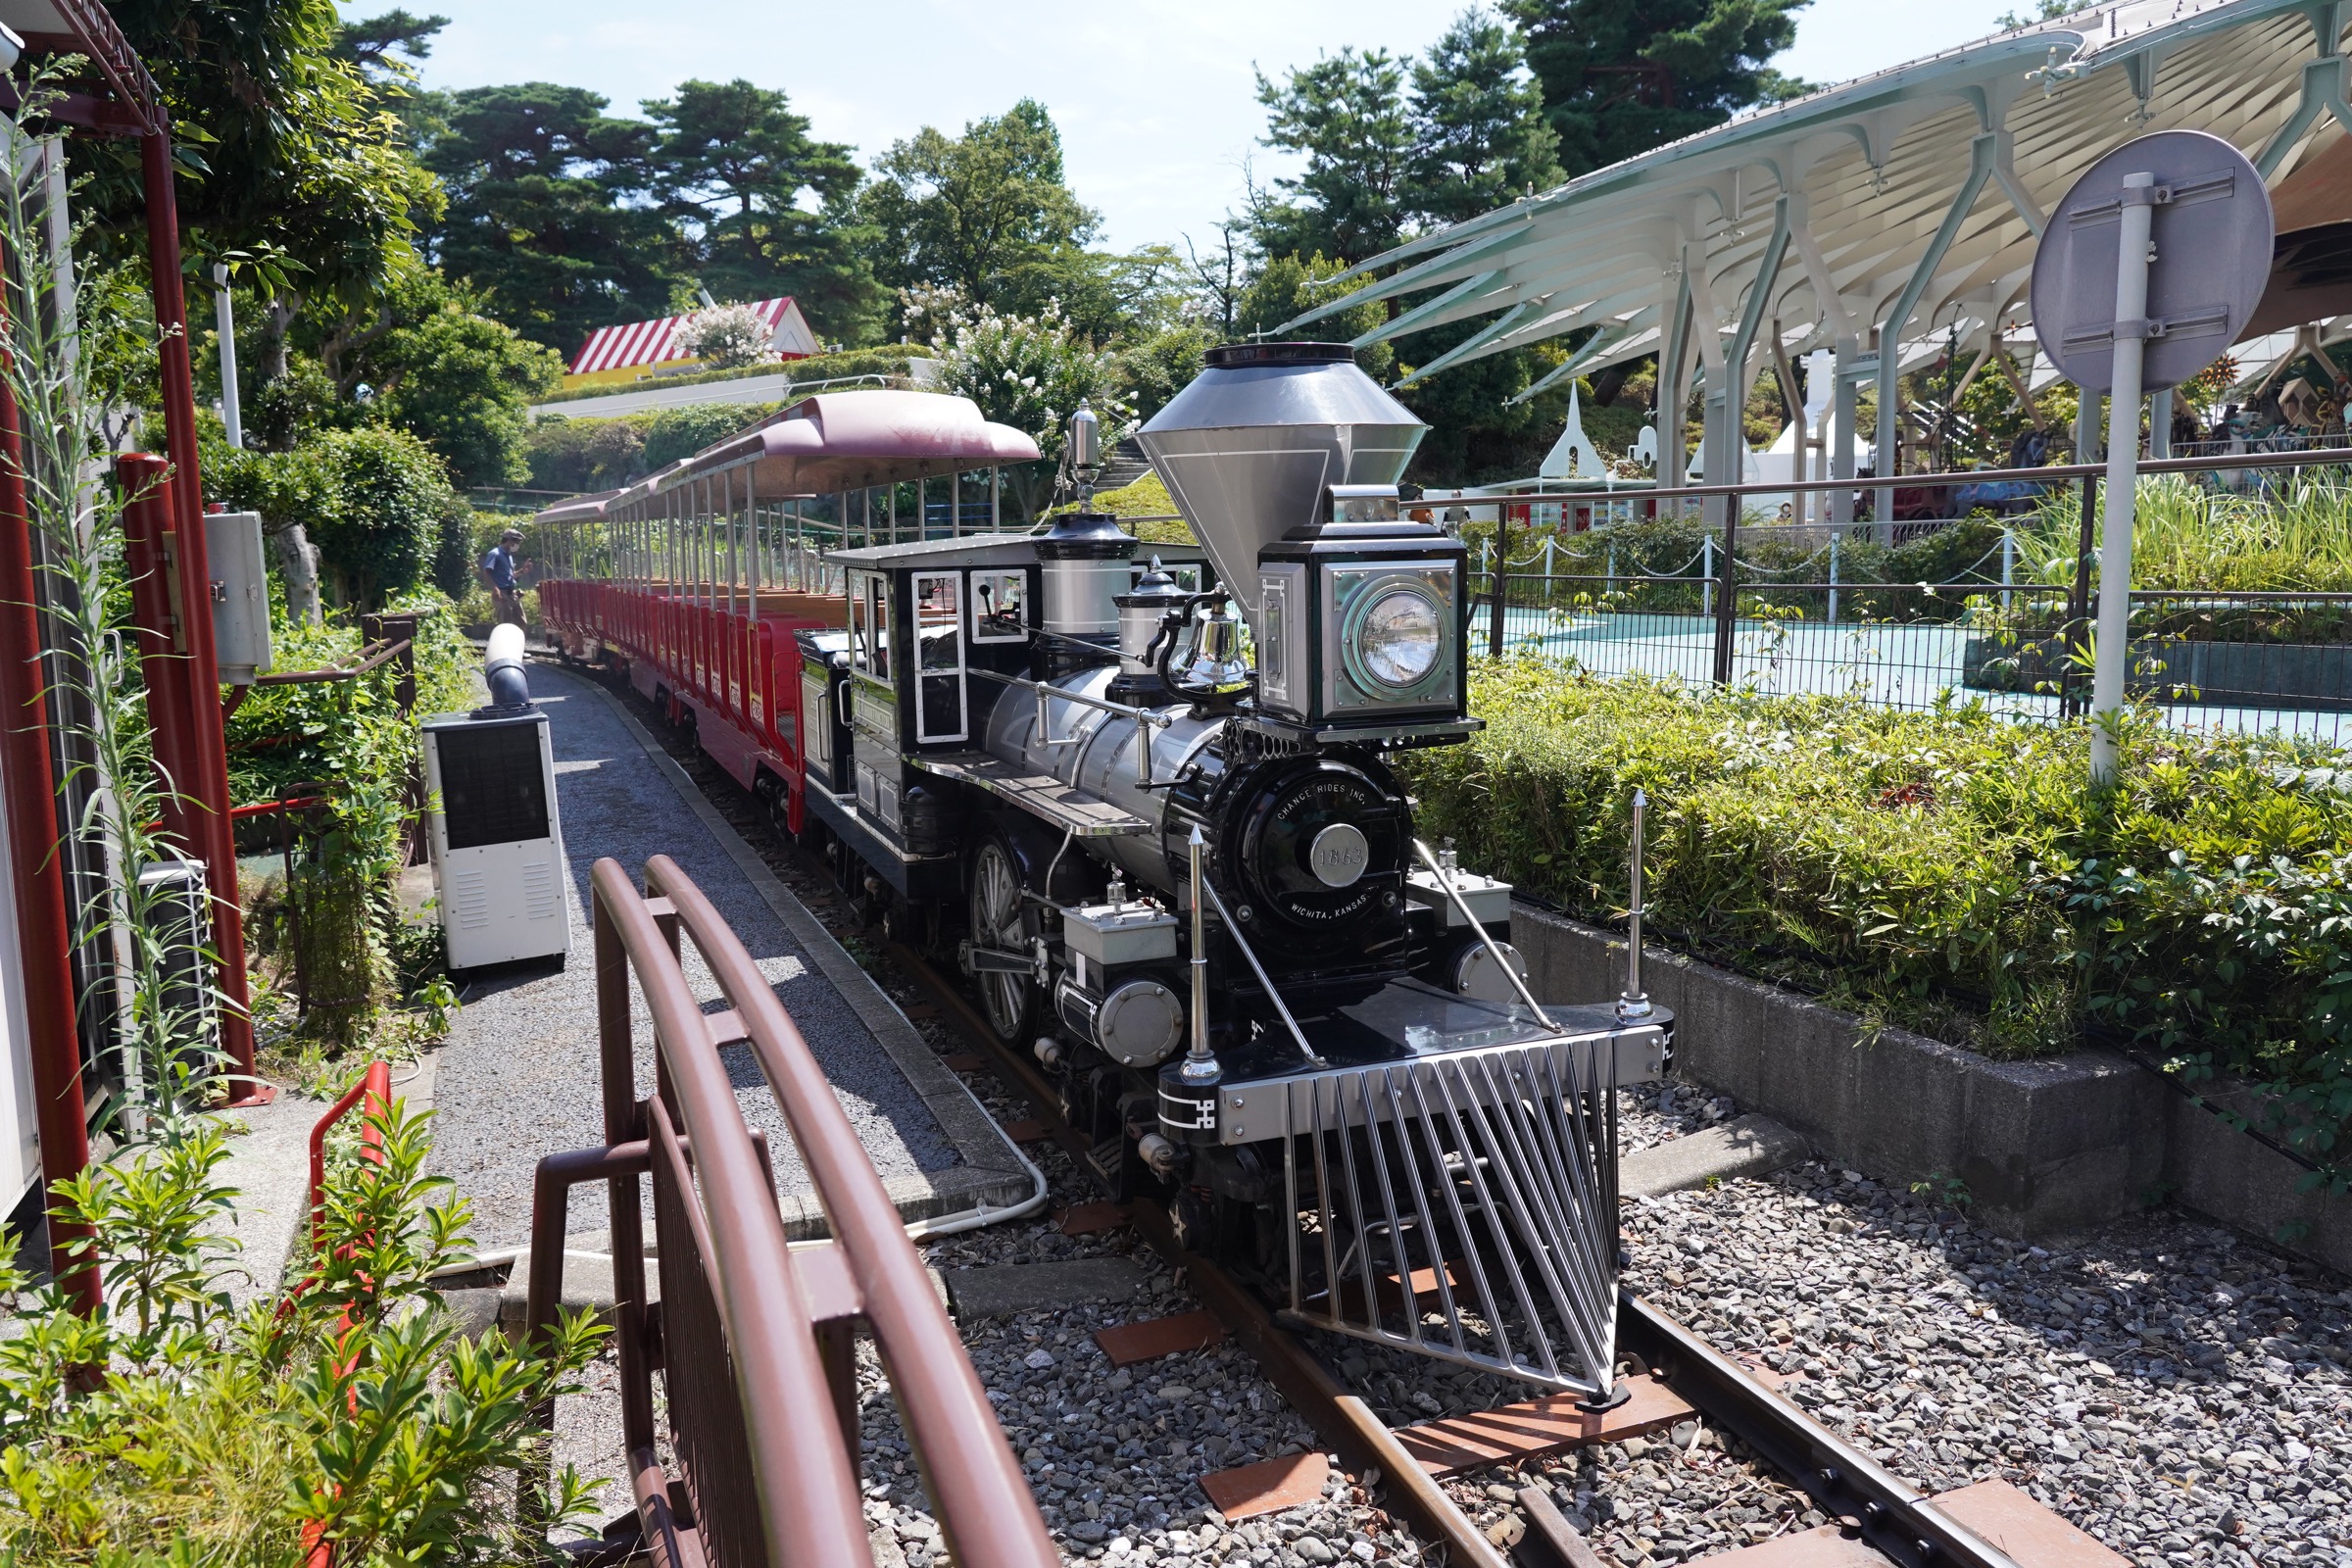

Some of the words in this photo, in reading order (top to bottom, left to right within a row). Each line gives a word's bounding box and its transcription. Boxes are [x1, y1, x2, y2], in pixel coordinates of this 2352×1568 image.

[1277, 789, 1312, 820] CHANCE
[1316, 783, 1346, 794] RIDES
[1319, 847, 1362, 866] 1863
[1335, 894, 1367, 917] KANSAS
